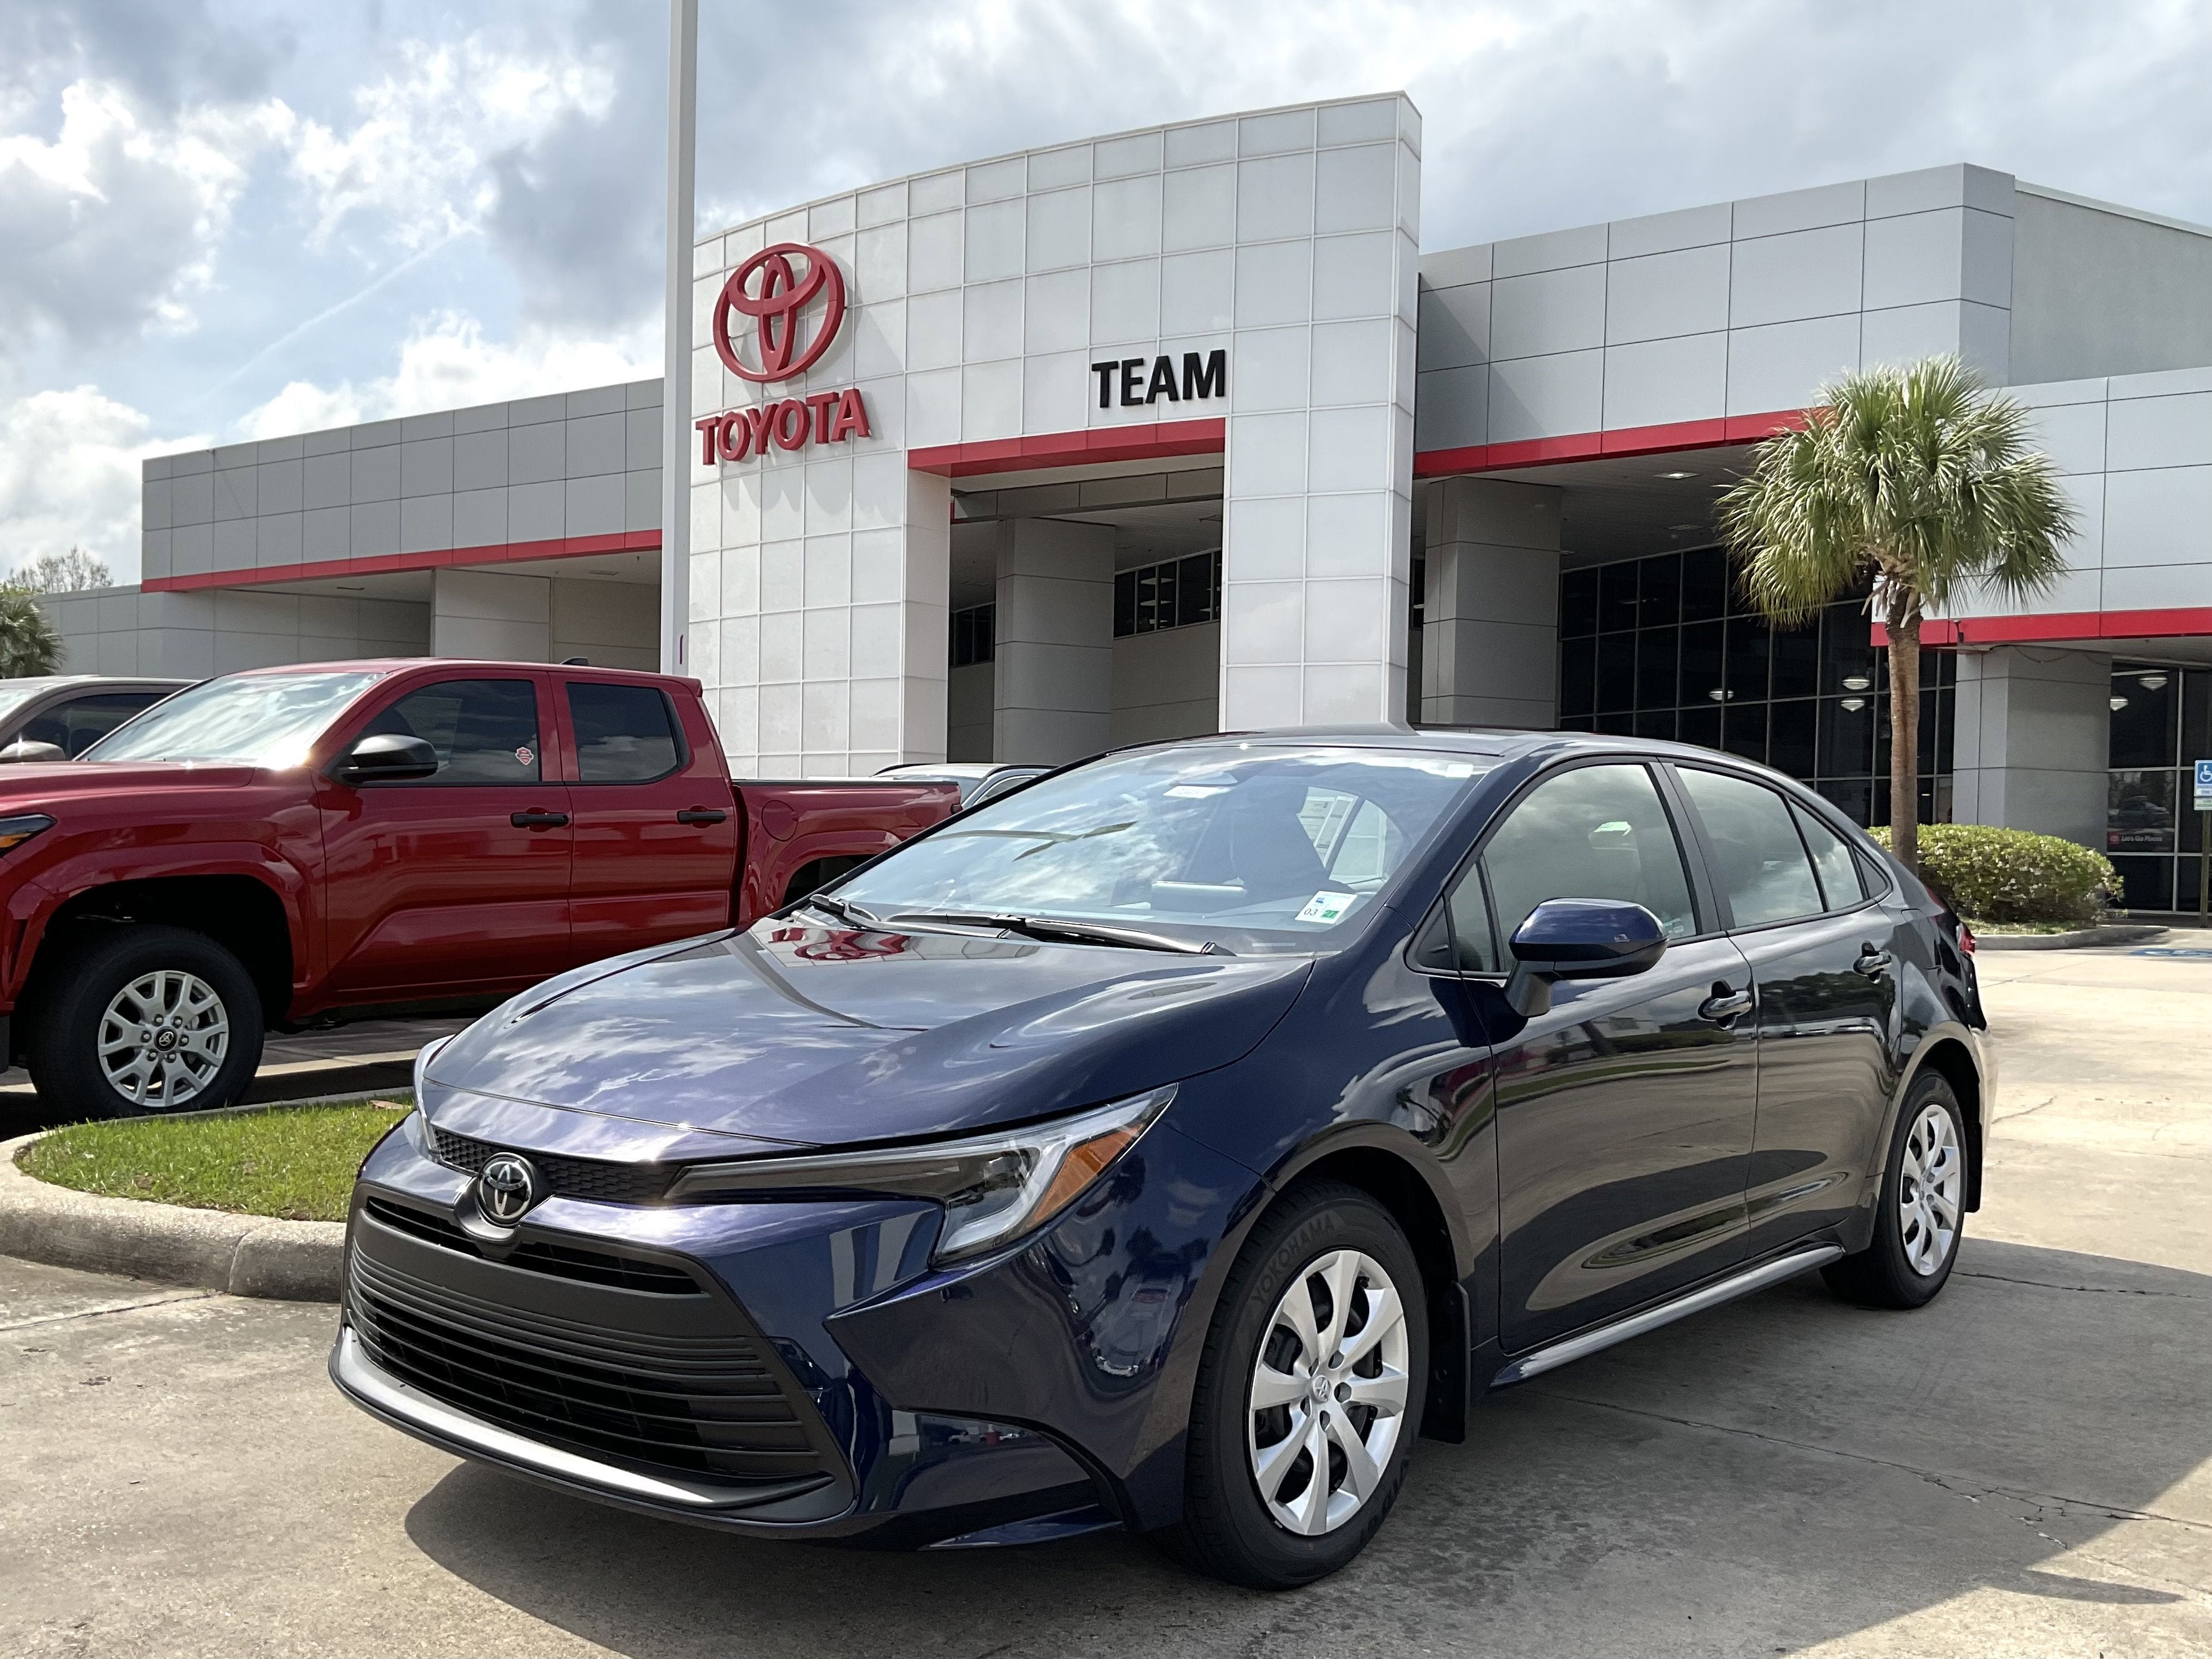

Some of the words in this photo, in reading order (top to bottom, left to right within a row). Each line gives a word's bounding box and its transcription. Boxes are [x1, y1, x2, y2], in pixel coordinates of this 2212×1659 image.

[1091, 349, 1225, 408] TEAM
[695, 388, 872, 465] TOYOTA
[1304, 908, 1319, 916] 03
[1322, 910, 1340, 918] 27
[1250, 1213, 1335, 1304] YOKOHAMA
